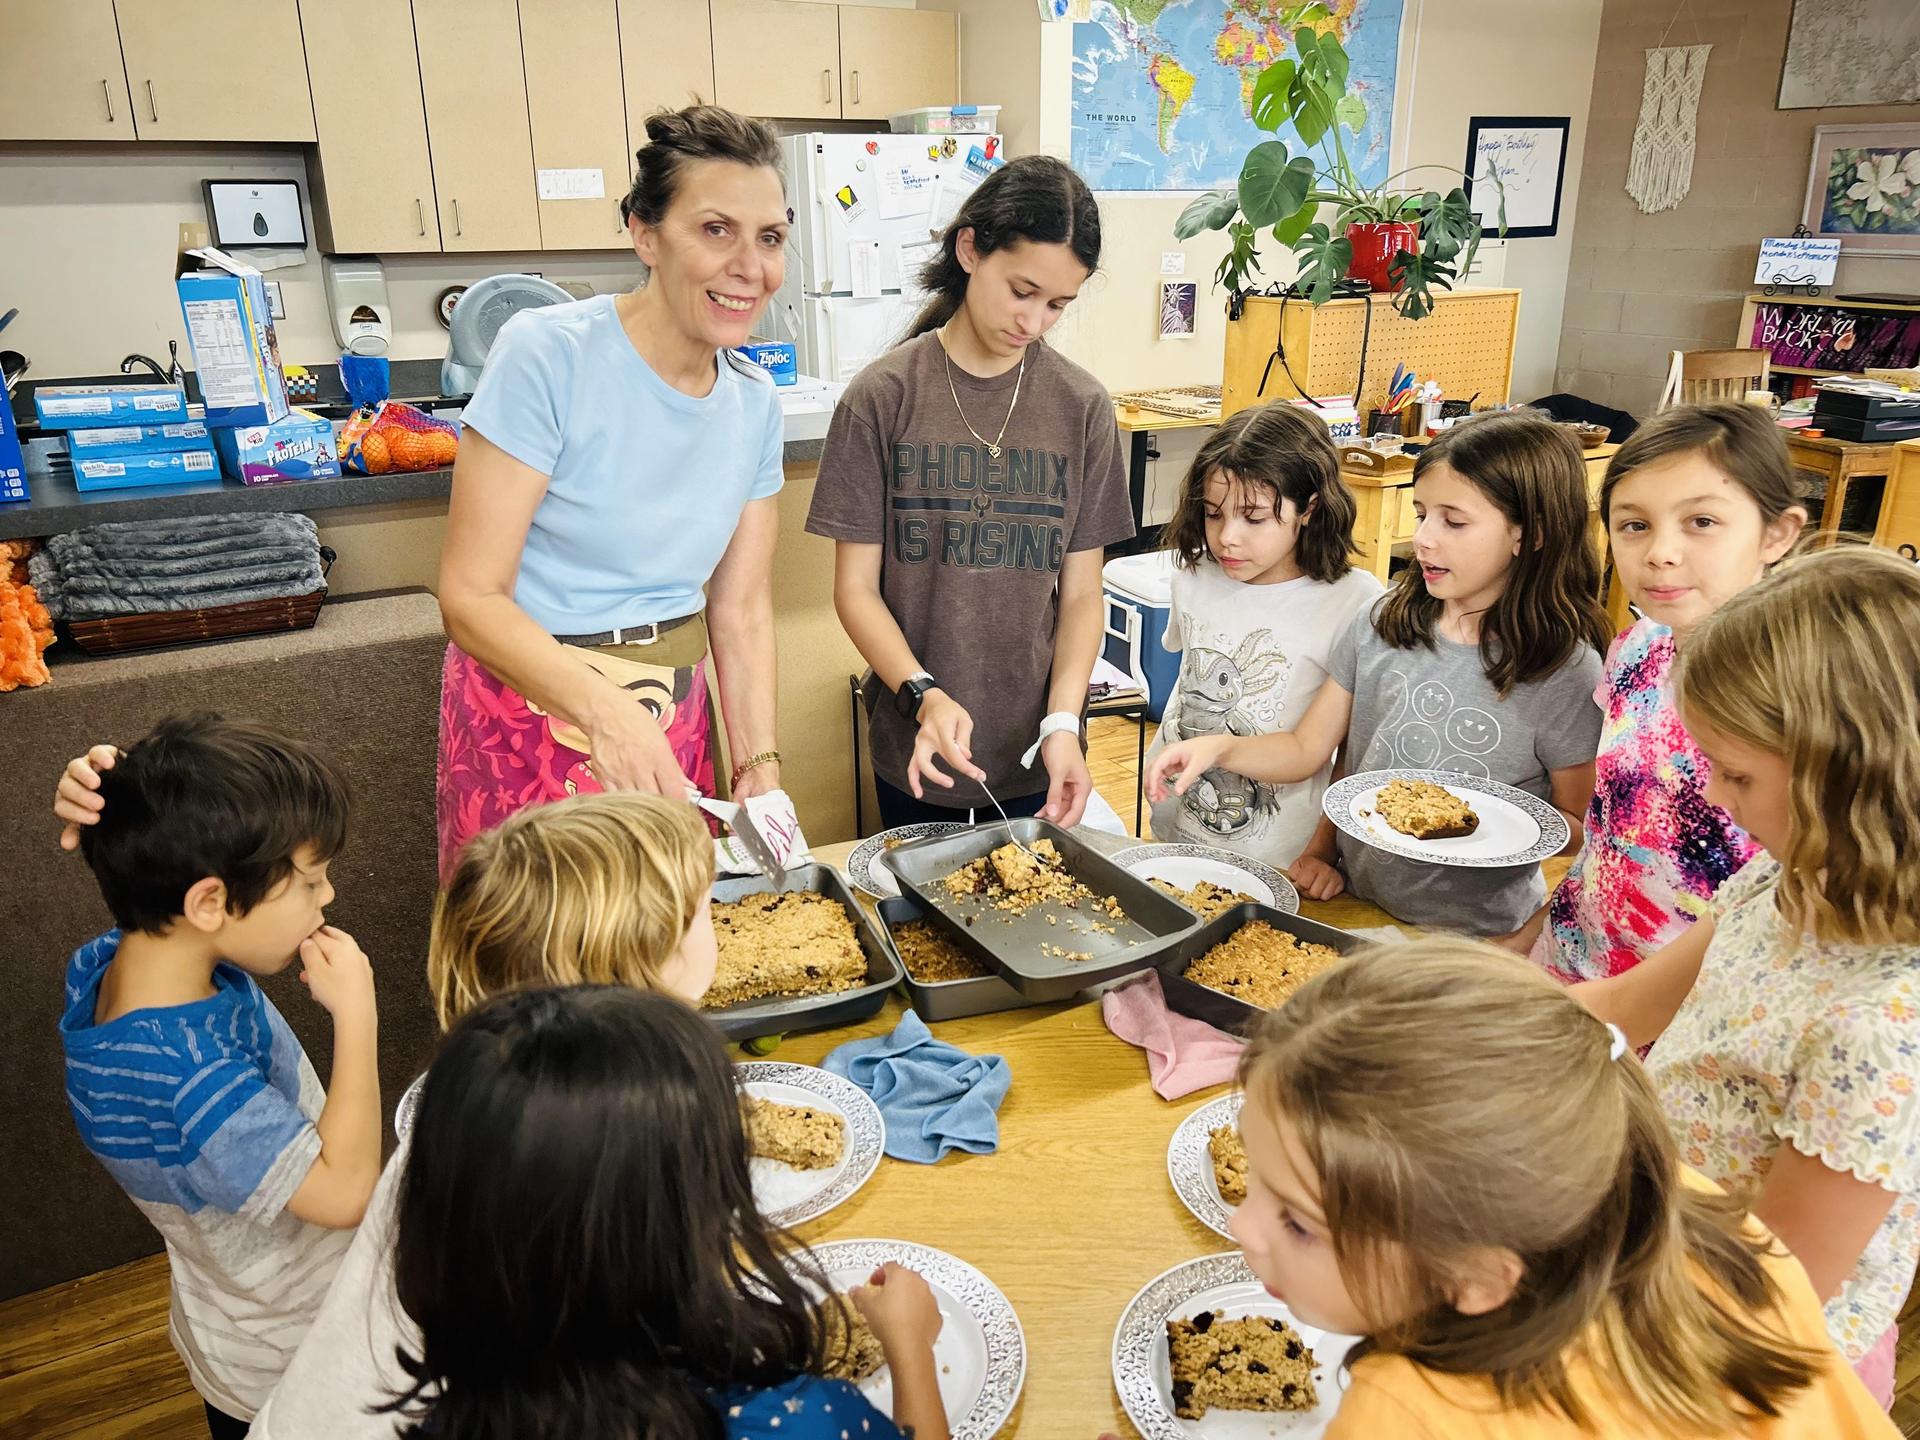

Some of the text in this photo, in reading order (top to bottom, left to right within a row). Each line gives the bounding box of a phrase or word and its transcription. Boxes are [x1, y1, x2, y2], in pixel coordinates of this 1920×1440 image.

[1086, 113, 1137, 122] THE WORLD
[759, 351, 790, 368] Ziploc
[267, 437, 315, 466] PROTEIN
[891, 442, 1068, 500] PHOENIX
[895, 517, 1063, 573] IS RISING
